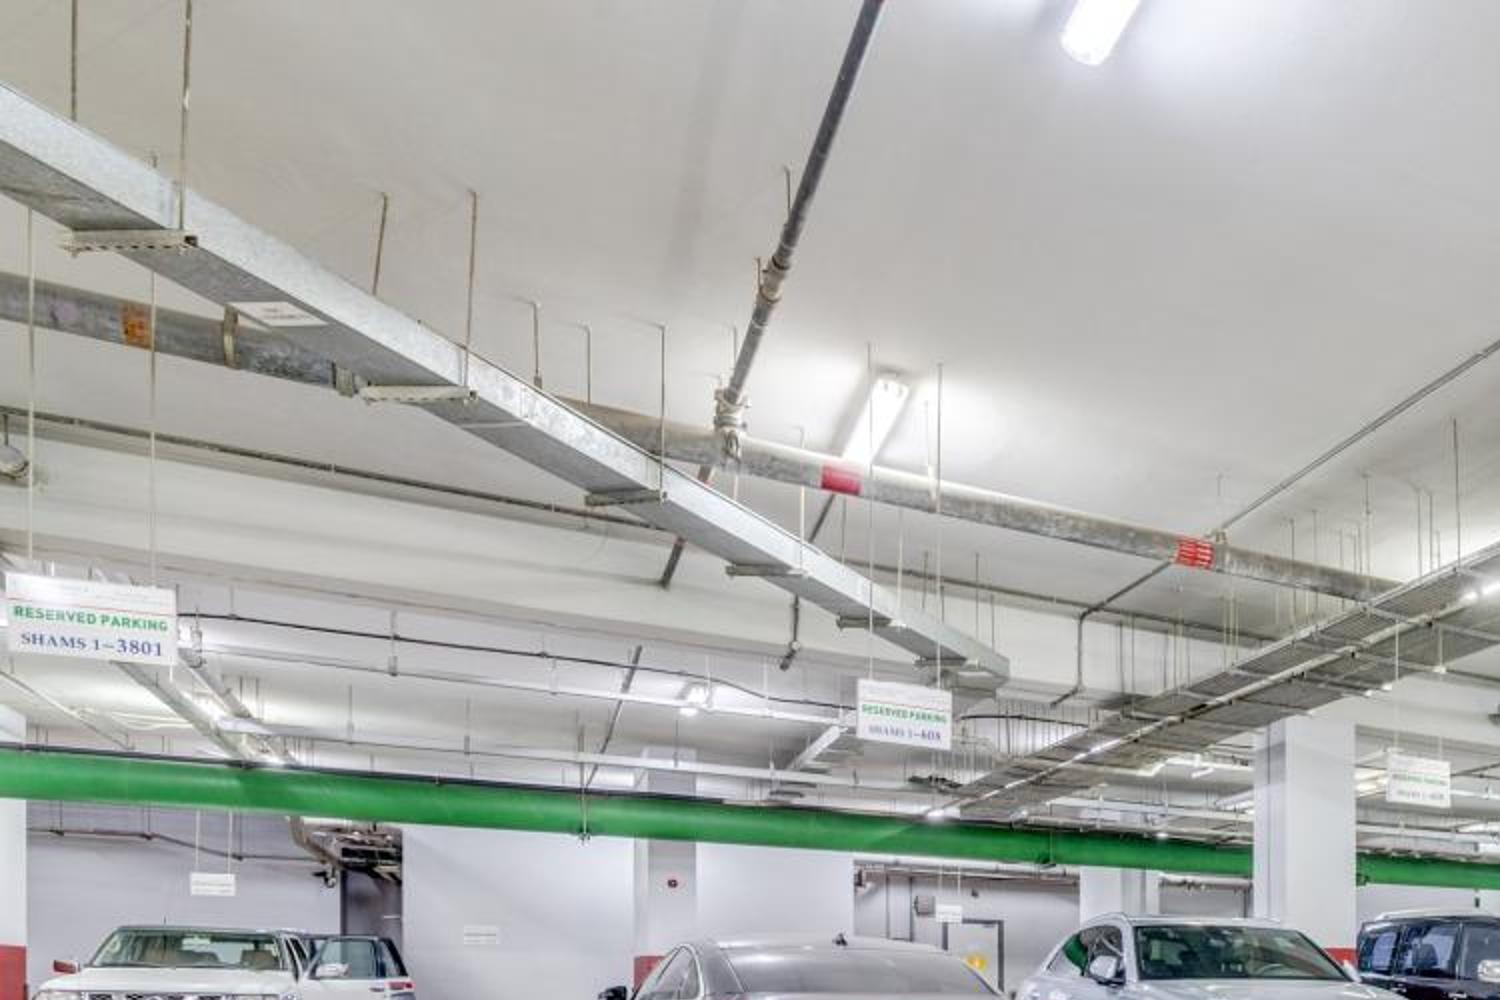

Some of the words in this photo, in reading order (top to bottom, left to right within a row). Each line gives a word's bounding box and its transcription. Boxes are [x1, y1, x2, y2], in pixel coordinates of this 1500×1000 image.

[13, 605, 97, 625] RESERVED
[101, 614, 168, 632] PARKING
[21, 632, 87, 650] SHAMS
